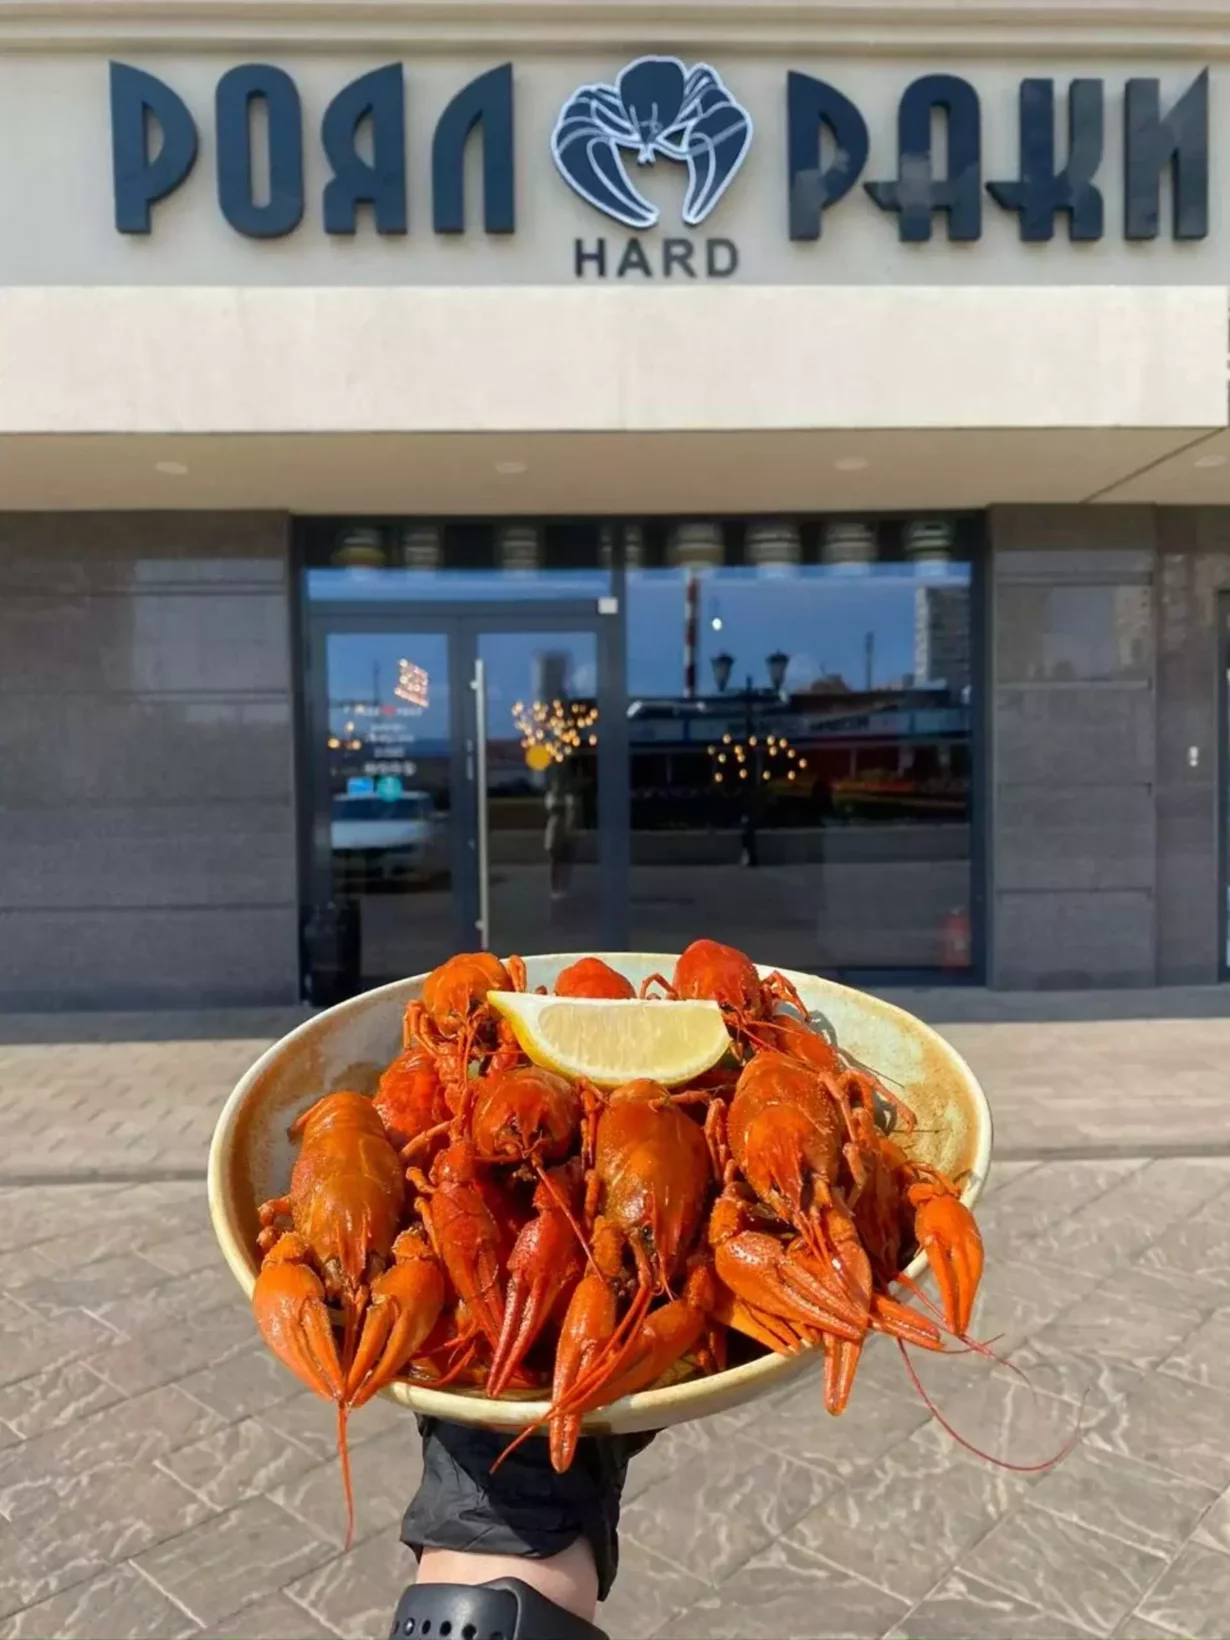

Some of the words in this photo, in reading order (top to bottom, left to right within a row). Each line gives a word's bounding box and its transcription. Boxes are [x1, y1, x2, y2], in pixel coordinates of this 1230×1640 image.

[109, 60, 516, 239] РОЯЛ
[787, 65, 1210, 241] РАКИ
[574, 238, 739, 278] HARD
